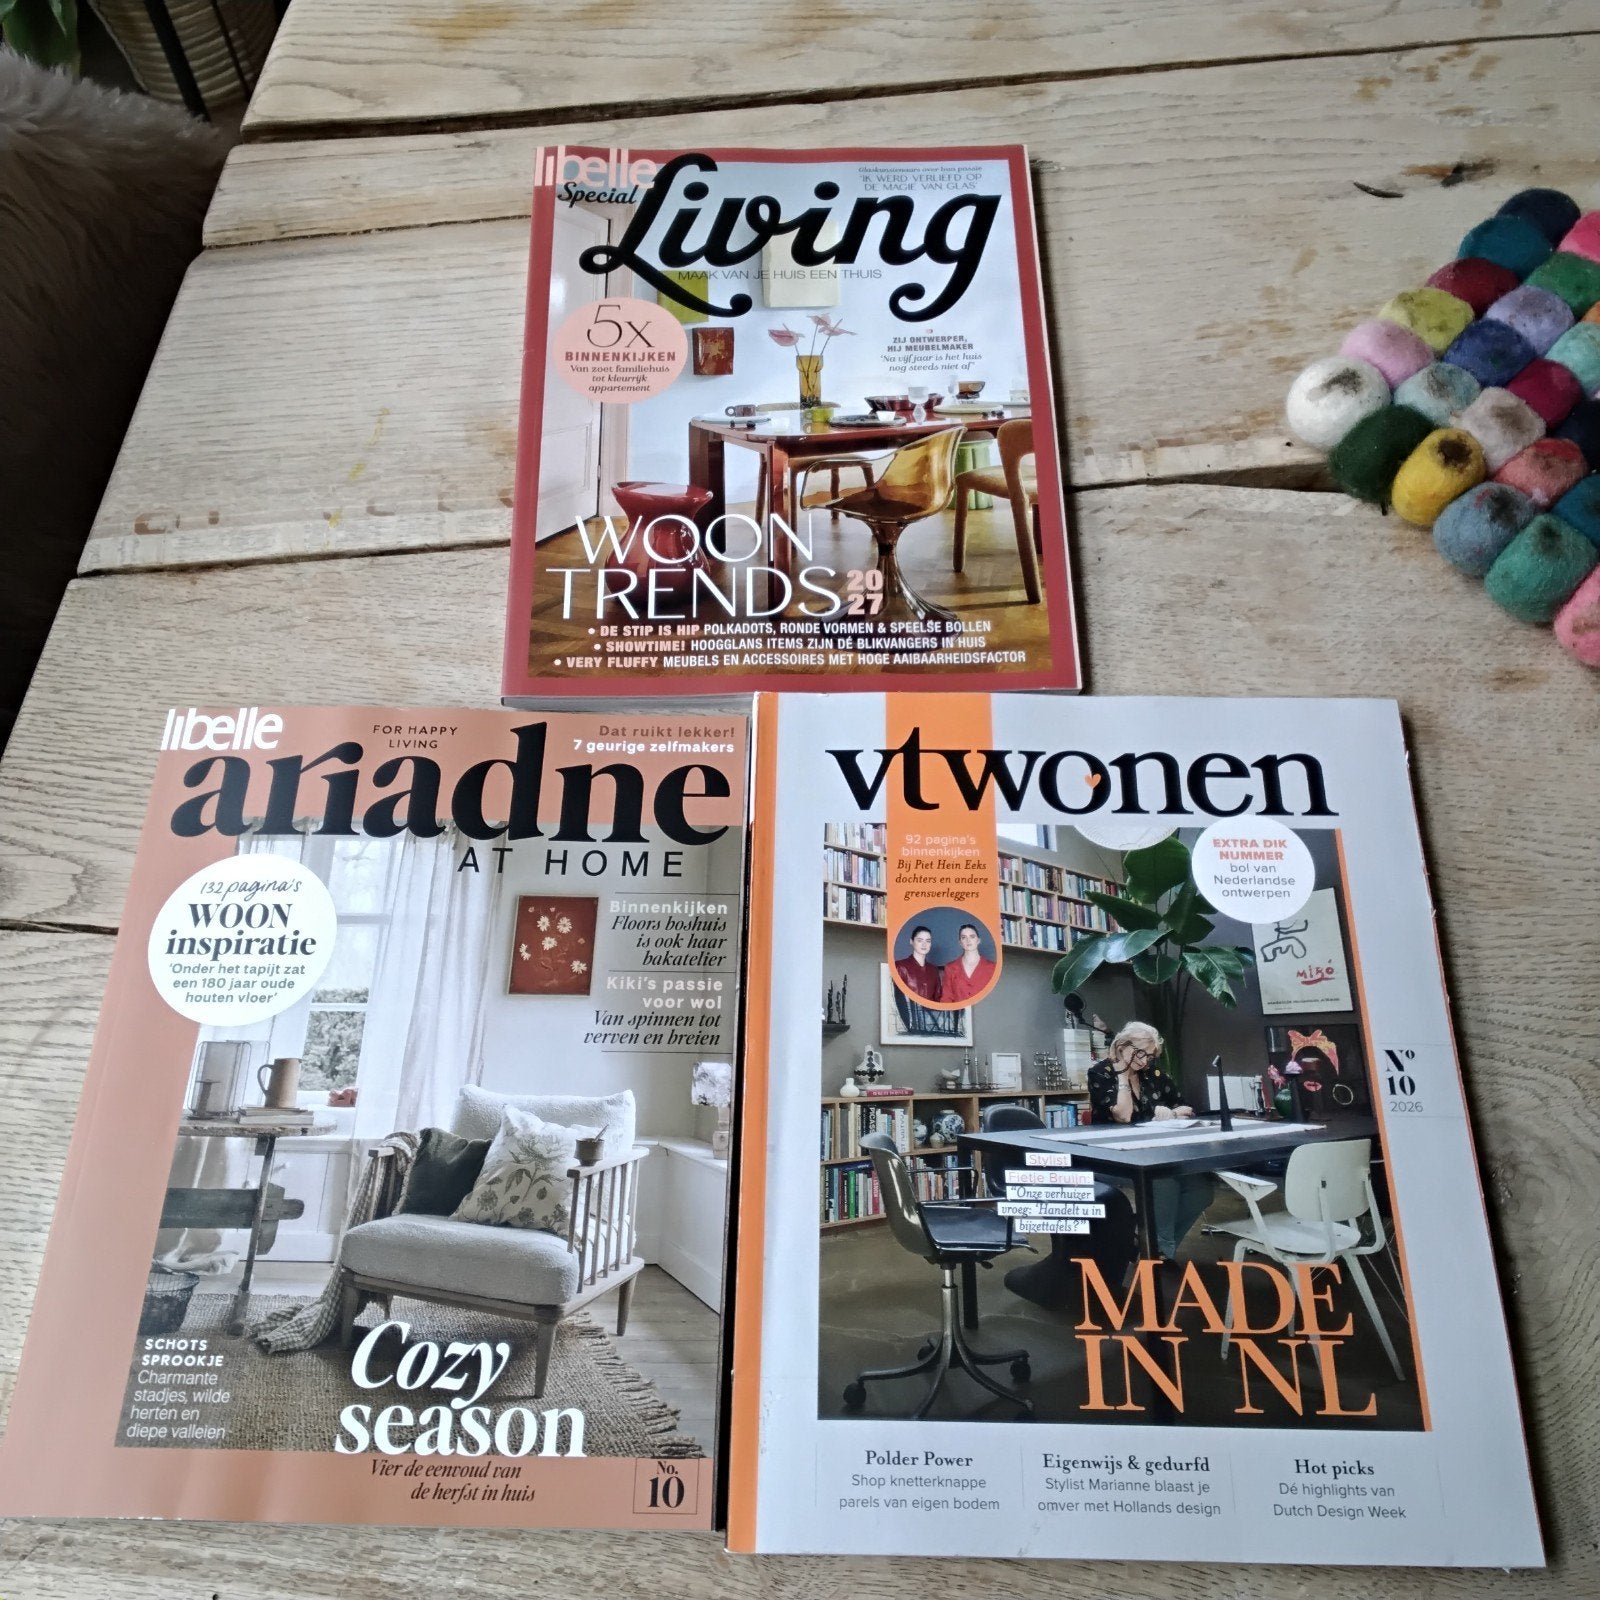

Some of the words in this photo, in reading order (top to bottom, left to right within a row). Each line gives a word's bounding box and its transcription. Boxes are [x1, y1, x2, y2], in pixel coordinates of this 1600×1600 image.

[557, 181, 640, 208] Special
[578, 153, 1001, 323] Living
[678, 271, 716, 280] MAAK
[721, 270, 750, 280] VAN
[753, 270, 770, 280] JE
[773, 270, 807, 280] HUIS
[810, 270, 838, 279] EEN
[841, 269, 883, 279] THUIS
[586, 304, 656, 348] 5x
[565, 351, 676, 362] BINNENKIJKEN
[576, 514, 813, 564] WOON
[847, 569, 883, 591] 20
[546, 566, 841, 619] TRENDS
[847, 594, 884, 615] 27
[600, 625, 618, 637] DE
[623, 625, 654, 637] STIP
[658, 625, 672, 636] IS
[676, 624, 700, 636] HIP
[704, 622, 777, 636] POLKADOTS,
[780, 622, 821, 634] RONDE
[823, 621, 873, 634] VORMEN
[877, 622, 887, 634] &
[890, 620, 942, 633] SPEELSE
[946, 620, 991, 633] BOLLEN
[606, 640, 685, 652] SHOWTIME!
[691, 639, 763, 651] HOOGGLANS
[767, 638, 803, 650] ITEMS
[807, 638, 833, 650] ZIJN
[837, 636, 853, 650] DÉ
[857, 636, 938, 649] BLIKVANGERS
[942, 636, 954, 648] IN
[958, 636, 986, 648] HUIS
[566, 656, 602, 668] VERY
[607, 656, 658, 668] FLUFFY
[663, 655, 719, 668] MEUBELS
[723, 654, 739, 666] EN
[742, 653, 825, 666] ACCESSOIRES
[828, 653, 853, 665] MET
[858, 653, 890, 665] HOGE
[893, 651, 1026, 665] AAIBAARHEIDSFACTOR
[160, 706, 284, 750] libelle
[373, 725, 402, 734] FOR
[408, 726, 457, 735] HAPPY
[599, 725, 626, 737] Dat
[633, 726, 672, 737] ruikt
[678, 727, 735, 738] lekker!
[389, 739, 438, 748] LIVING
[573, 739, 582, 750] 7
[586, 741, 645, 754] geurige
[649, 741, 734, 752] zelfmakers
[825, 727, 1340, 818] vtwonen
[170, 721, 730, 845] ariadne
[1213, 839, 1259, 848] EXTRA
[1263, 839, 1288, 848] DIK
[902, 846, 980, 858] binnenkijken
[1219, 851, 1284, 860] NUMMER
[457, 847, 513, 873] AT
[544, 850, 683, 877] HOME
[897, 859, 911, 872] Bij
[914, 859, 934, 869] Piet
[937, 860, 961, 869] Hein
[964, 860, 987, 869] Eeks
[1230, 863, 1250, 873] bol
[1253, 865, 1276, 873] van
[895, 873, 937, 883] dochters
[954, 874, 989, 884] andere
[1214, 875, 1296, 886] Nederlandse
[904, 888, 980, 901] grensverleggers
[1222, 888, 1290, 899] ontwerpen
[188, 902, 293, 928] WOON
[610, 900, 728, 917] Binnenkijken
[611, 915, 661, 931] Floors
[665, 916, 726, 931] boshuis
[165, 929, 317, 961] inspiratie
[636, 934, 650, 948] is
[655, 933, 683, 948] ook
[687, 933, 727, 949] haar
[642, 951, 726, 967] bakatelier
[217, 963, 240, 974] het
[243, 963, 281, 976] tapijt
[284, 964, 305, 974] zat
[173, 980, 198, 988] een
[201, 978, 226, 988] 180
[228, 979, 257, 991] jaar
[260, 978, 295, 988] oude
[606, 976, 656, 990] Kiki's
[663, 978, 723, 993] passie
[185, 992, 233, 1002] houten
[238, 992, 278, 1002] vloer'
[642, 997, 684, 1008] voor
[690, 996, 722, 1009] wol
[595, 1010, 624, 1025] Van
[628, 1011, 695, 1029] spinnen
[700, 1013, 721, 1027] tot
[584, 1032, 639, 1044] verven
[643, 1033, 662, 1045] en
[667, 1030, 720, 1046] breien
[1029, 1154, 1068, 1166] Stylist
[1070, 1258, 1353, 1336] MADE
[145, 1339, 208, 1351] SCHOTS
[142, 1355, 224, 1366] SPROOKJE
[351, 1321, 510, 1409] Cozy
[138, 1370, 218, 1385] Charmante
[1074, 1334, 1189, 1413] IN
[1228, 1338, 1378, 1416] NL
[134, 1388, 188, 1405] stadjes,
[193, 1389, 230, 1403] wilde
[130, 1405, 177, 1420] herten
[181, 1409, 200, 1420] en
[126, 1423, 168, 1440] diepe
[172, 1424, 226, 1439] valleien
[335, 1403, 587, 1457] season
[865, 1450, 919, 1466] Polder
[923, 1451, 973, 1467] Power
[1043, 1453, 1123, 1474] Eigenwijs
[1128, 1455, 1141, 1470] &
[1145, 1456, 1210, 1475] gedurfd
[372, 1459, 402, 1476] Vier
[404, 1460, 424, 1477] de
[425, 1461, 491, 1478] eenvoud
[492, 1466, 521, 1478] van
[1294, 1459, 1328, 1474] Hot
[1332, 1461, 1375, 1480] picks
[851, 1474, 886, 1489] Shop
[890, 1475, 987, 1490] knetterknappe
[1045, 1478, 1085, 1492] Stylist
[1089, 1479, 1150, 1492] Marianne
[1155, 1480, 1195, 1492] blaast
[1197, 1482, 1211, 1496] je
[1279, 1482, 1299, 1495] Dé
[1302, 1484, 1368, 1498] highlights
[1370, 1487, 1395, 1497] van
[411, 1482, 430, 1500] de
[432, 1483, 479, 1504] herfst
[481, 1485, 497, 1500] in
[501, 1484, 535, 1502] huis
[649, 1476, 685, 1508] 10
[839, 1496, 880, 1510] parels
[884, 1499, 907, 1508] van
[911, 1498, 949, 1511] eigen
[953, 1497, 1000, 1510] bodem
[1038, 1502, 1080, 1511] omver
[1084, 1502, 1109, 1512] met
[1113, 1500, 1172, 1513] Hollands
[1176, 1503, 1221, 1517] design
[1273, 1504, 1313, 1517] Dutch
[1317, 1504, 1364, 1520] Design
[1367, 1506, 1407, 1518] Week
